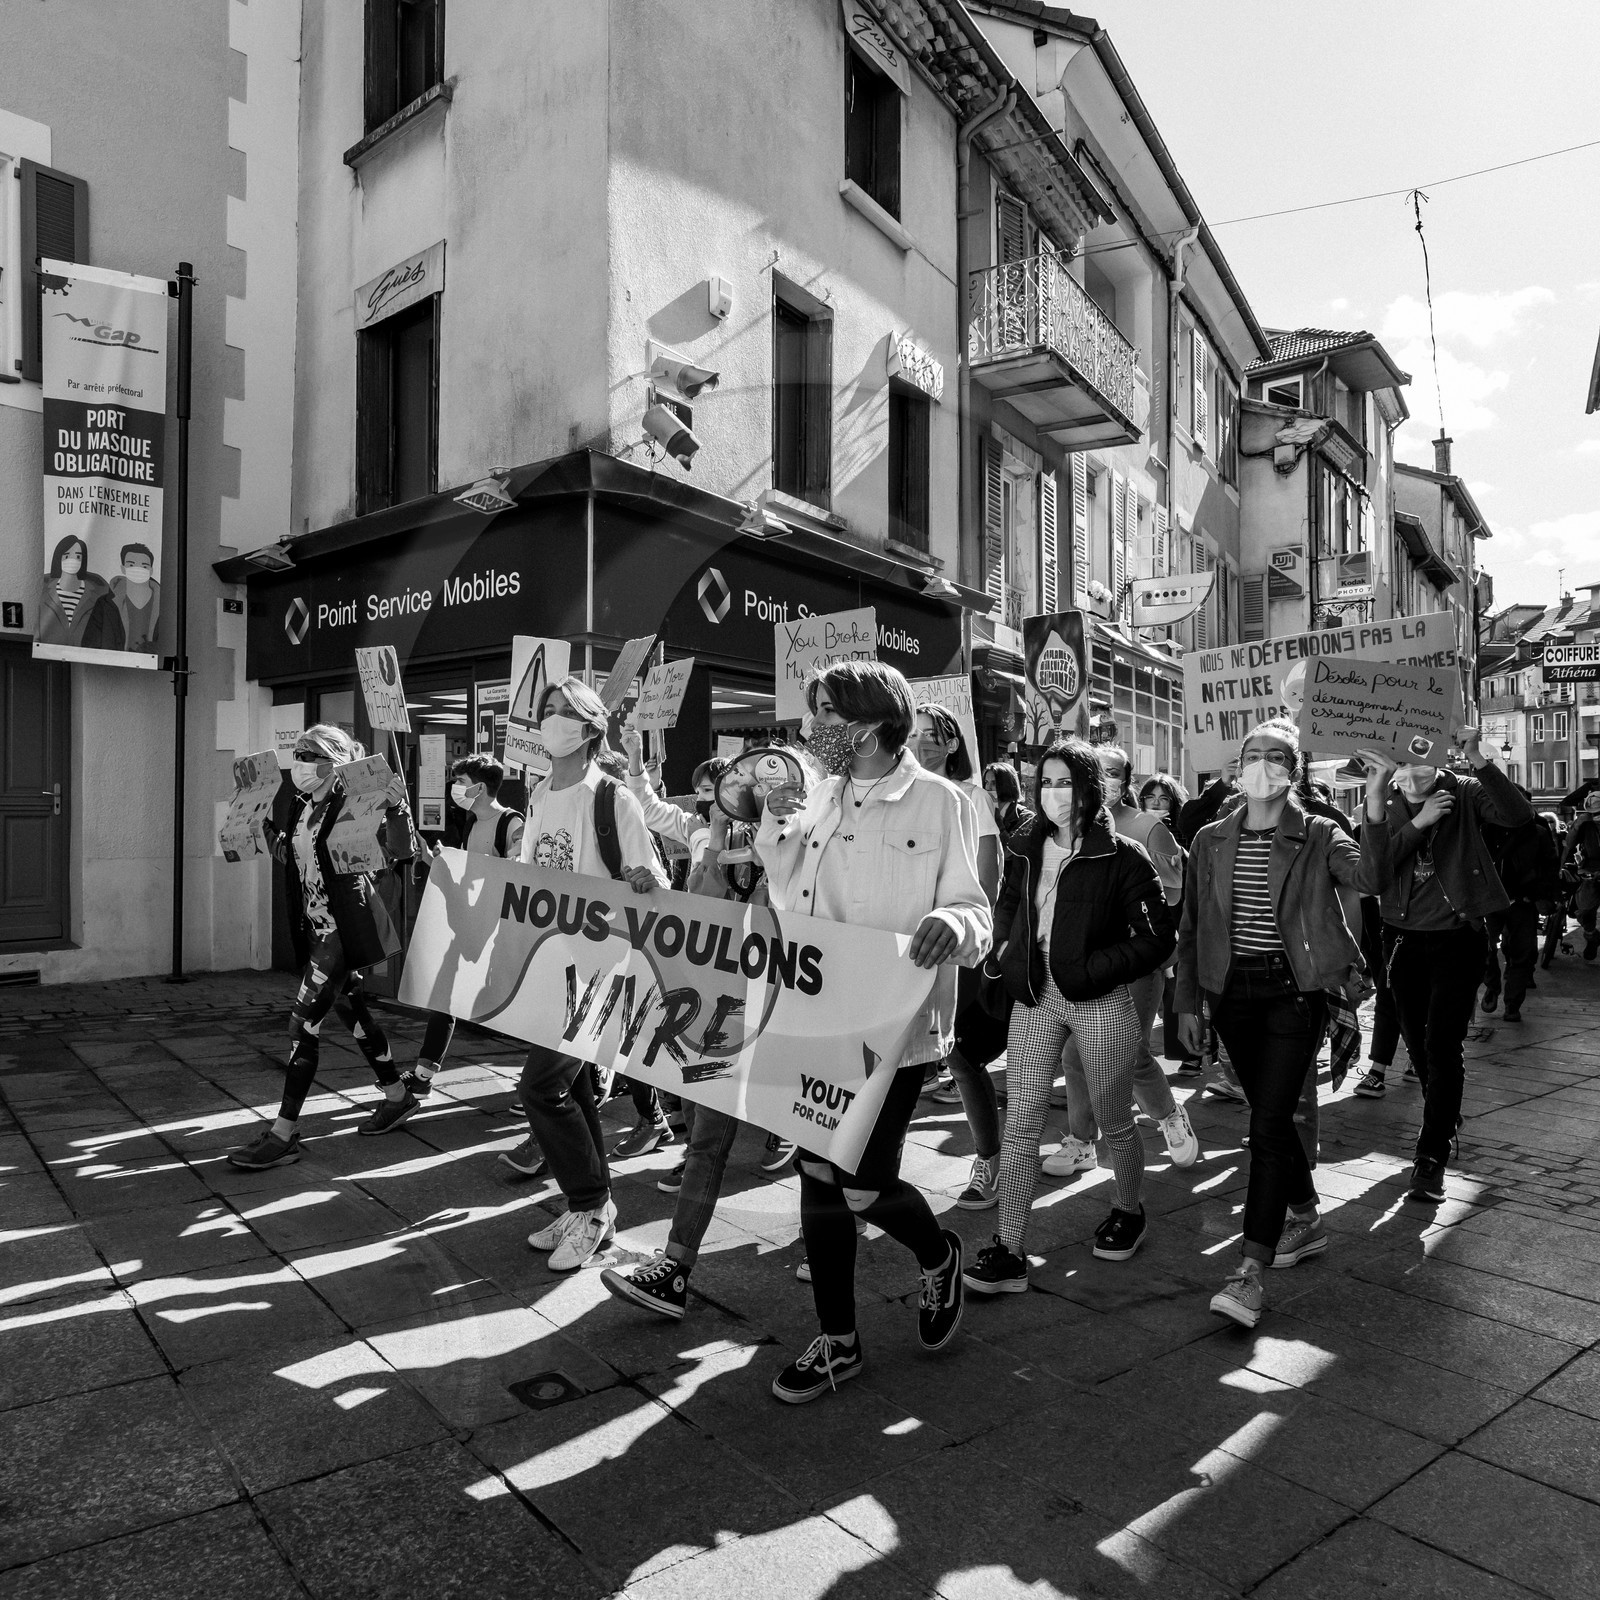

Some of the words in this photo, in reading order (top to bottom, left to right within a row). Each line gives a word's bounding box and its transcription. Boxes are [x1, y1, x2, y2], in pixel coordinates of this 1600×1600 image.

[94, 326, 141, 345] Gap
[67, 378, 80, 389] Par
[83, 384, 105, 393] arrêté
[107, 384, 144, 398] préfectoral
[86, 409, 126, 430] PORT
[58, 428, 81, 450] DU
[87, 431, 152, 458] MASQUE
[54, 451, 155, 482] OBLIGATOIRE
[57, 485, 84, 499] DANS
[89, 485, 150, 507] L'ENSEMBLE
[58, 501, 74, 514] DU
[79, 501, 149, 523] CENTRE-VILLE
[1338, 587, 1364, 595] PHOTO
[1341, 578, 1366, 587] Kodak
[230, 602, 237, 611] 2
[318, 599, 357, 629] Point
[366, 587, 432, 621] Service
[443, 569, 521, 607] Mobiles
[7, 605, 20, 625] 1
[744, 589, 789, 623] Point
[876, 624, 920, 655] Mobiles
[784, 624, 819, 660] You
[1200, 652, 1224, 674] NOUS
[1231, 647, 1246, 669] NE
[1248, 630, 1355, 669] DÉFENDONS
[1360, 627, 1393, 649] PAS
[1402, 620, 1426, 640] LA
[1545, 646, 1600, 663] COIFFURE
[1548, 666, 1597, 679] Athéna
[927, 678, 968, 697] NATURE
[1201, 674, 1273, 704] NATURE
[1427, 676, 1443, 695] le
[1194, 711, 1214, 734] LA
[1311, 707, 1373, 725] essayons
[1376, 713, 1391, 726] de
[1395, 717, 1442, 736] changer
[1410, 707, 1445, 721] nous
[1311, 722, 1324, 737] le
[1333, 730, 1386, 742] monde
[500, 882, 611, 942] NOUS
[624, 906, 824, 996] VOULONS
[562, 964, 747, 1084] VIVRE
[792, 1101, 814, 1122] FOR
